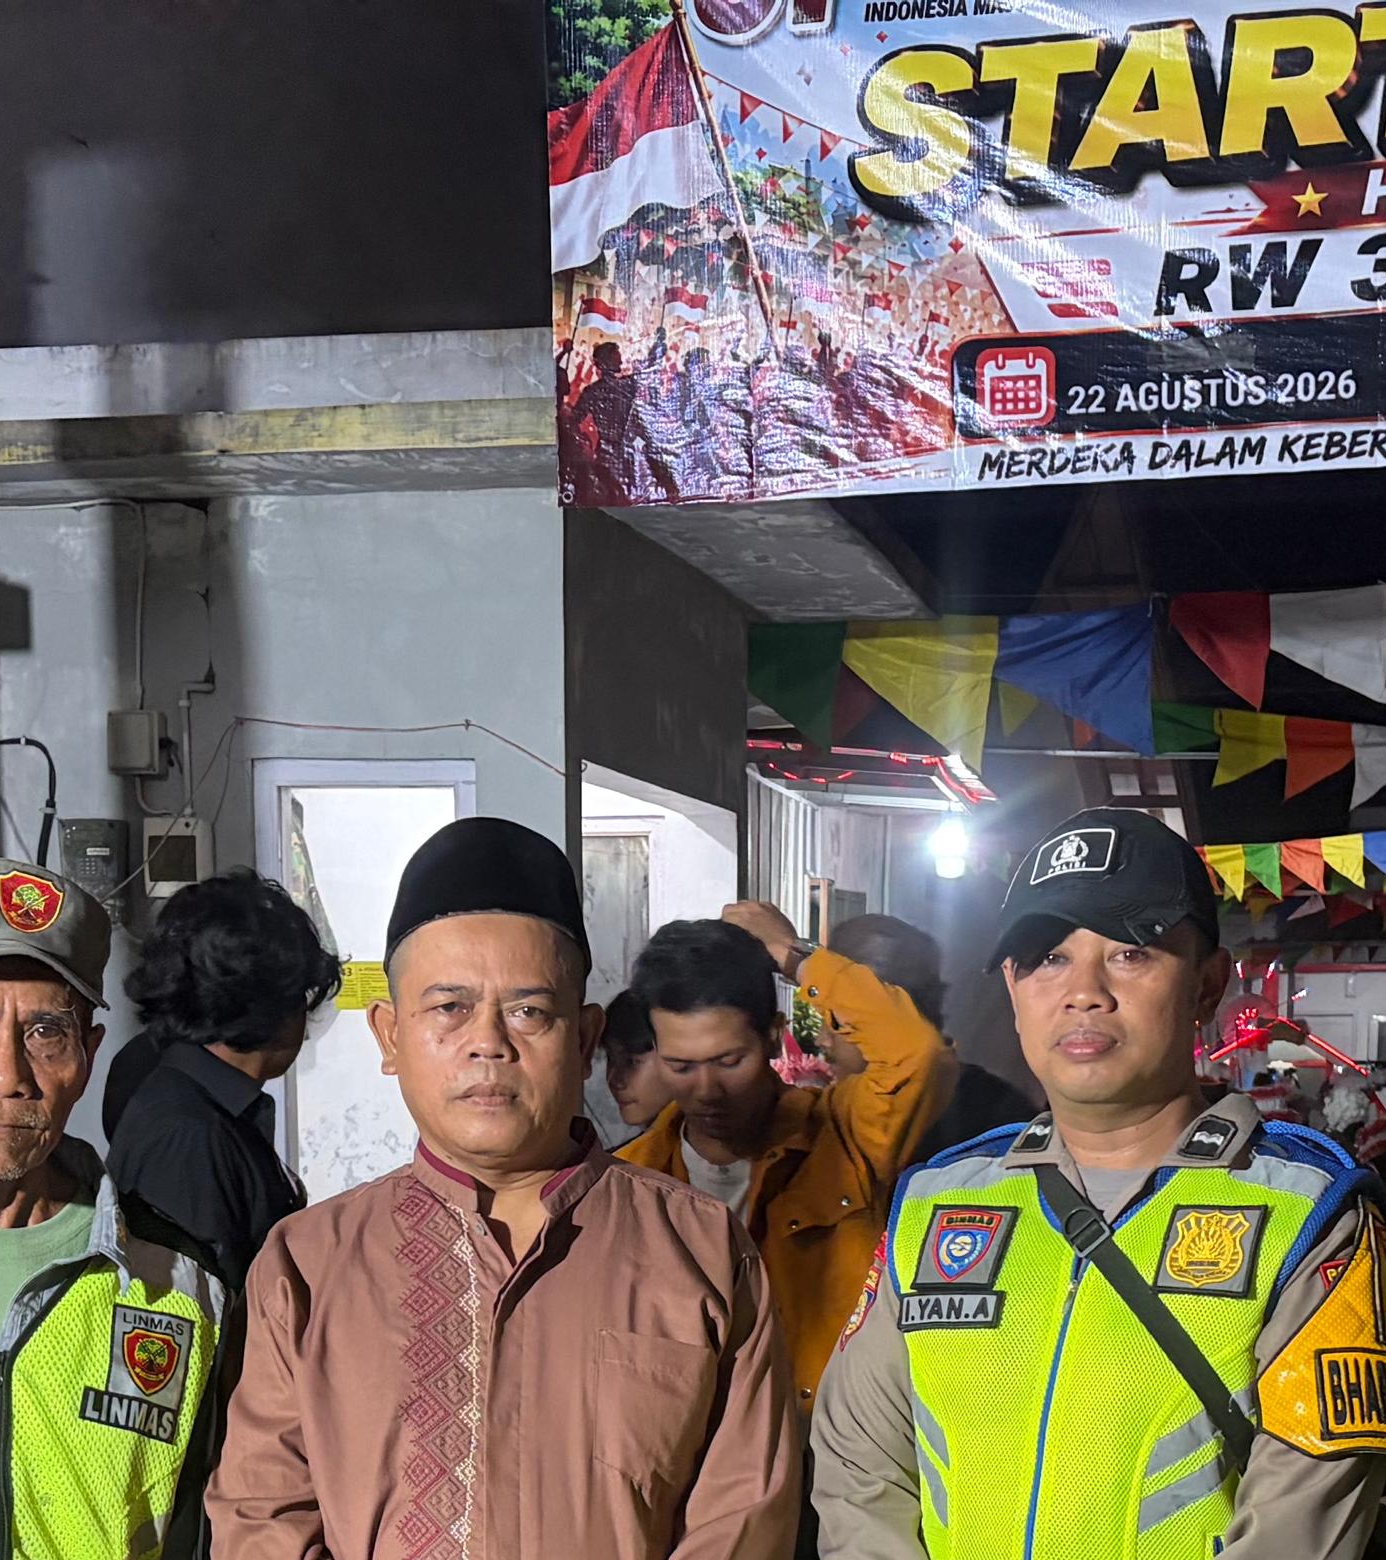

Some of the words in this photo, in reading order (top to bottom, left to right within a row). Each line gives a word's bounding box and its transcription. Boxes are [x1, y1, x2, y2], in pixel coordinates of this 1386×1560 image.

[864, 0, 968, 22] INDONESIA
[1153, 238, 1325, 318] RW
[1066, 384, 1107, 414] 22
[1115, 375, 1268, 413] AGUSTUS
[1271, 369, 1357, 402] 2026
[977, 440, 1137, 481] MERDEKA
[1148, 435, 1267, 471] DALAM
[122, 1311, 185, 1336] LINMAS
[83, 1390, 175, 1441] LINMAS
